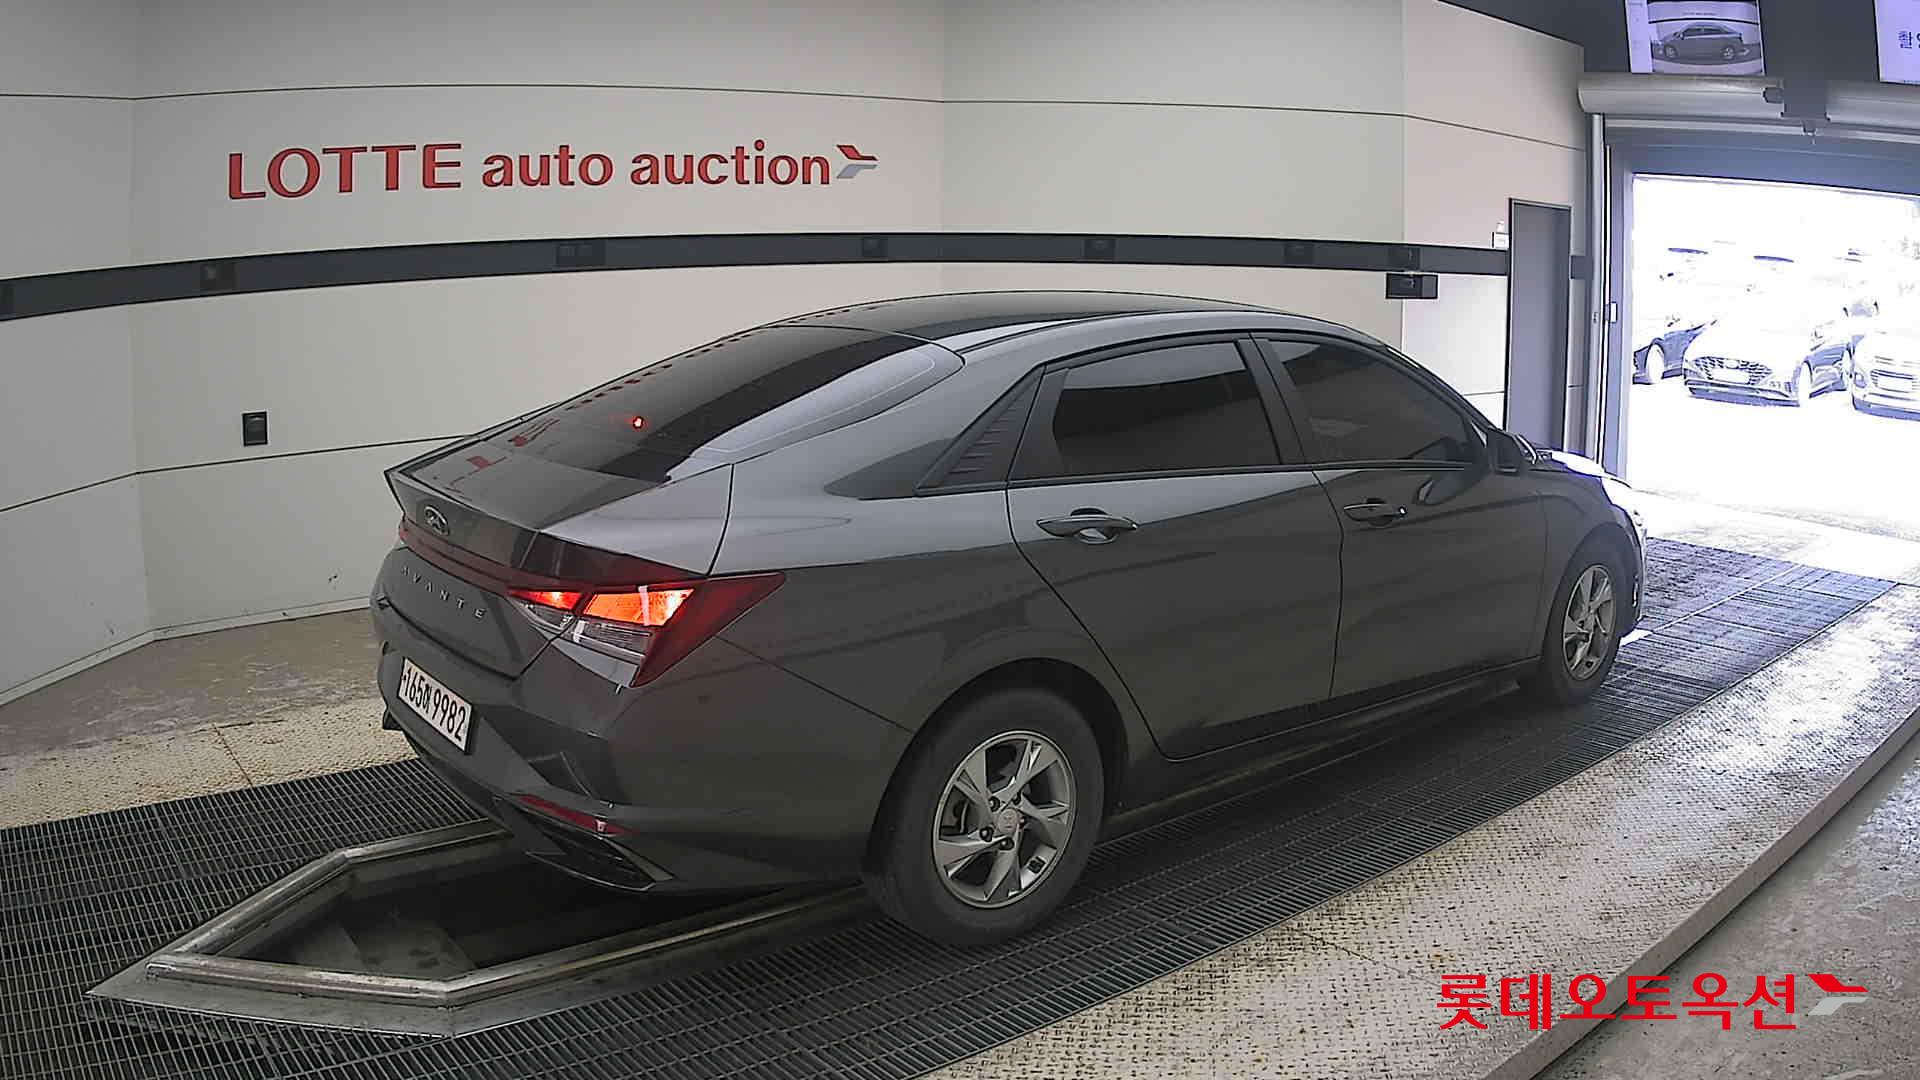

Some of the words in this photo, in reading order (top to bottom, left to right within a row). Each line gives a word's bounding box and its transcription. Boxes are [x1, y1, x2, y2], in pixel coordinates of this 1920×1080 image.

[228, 143, 462, 200] LOTTE
[482, 144, 614, 188] auto
[630, 139, 830, 185] auction
[402, 566, 485, 619] AVANTE
